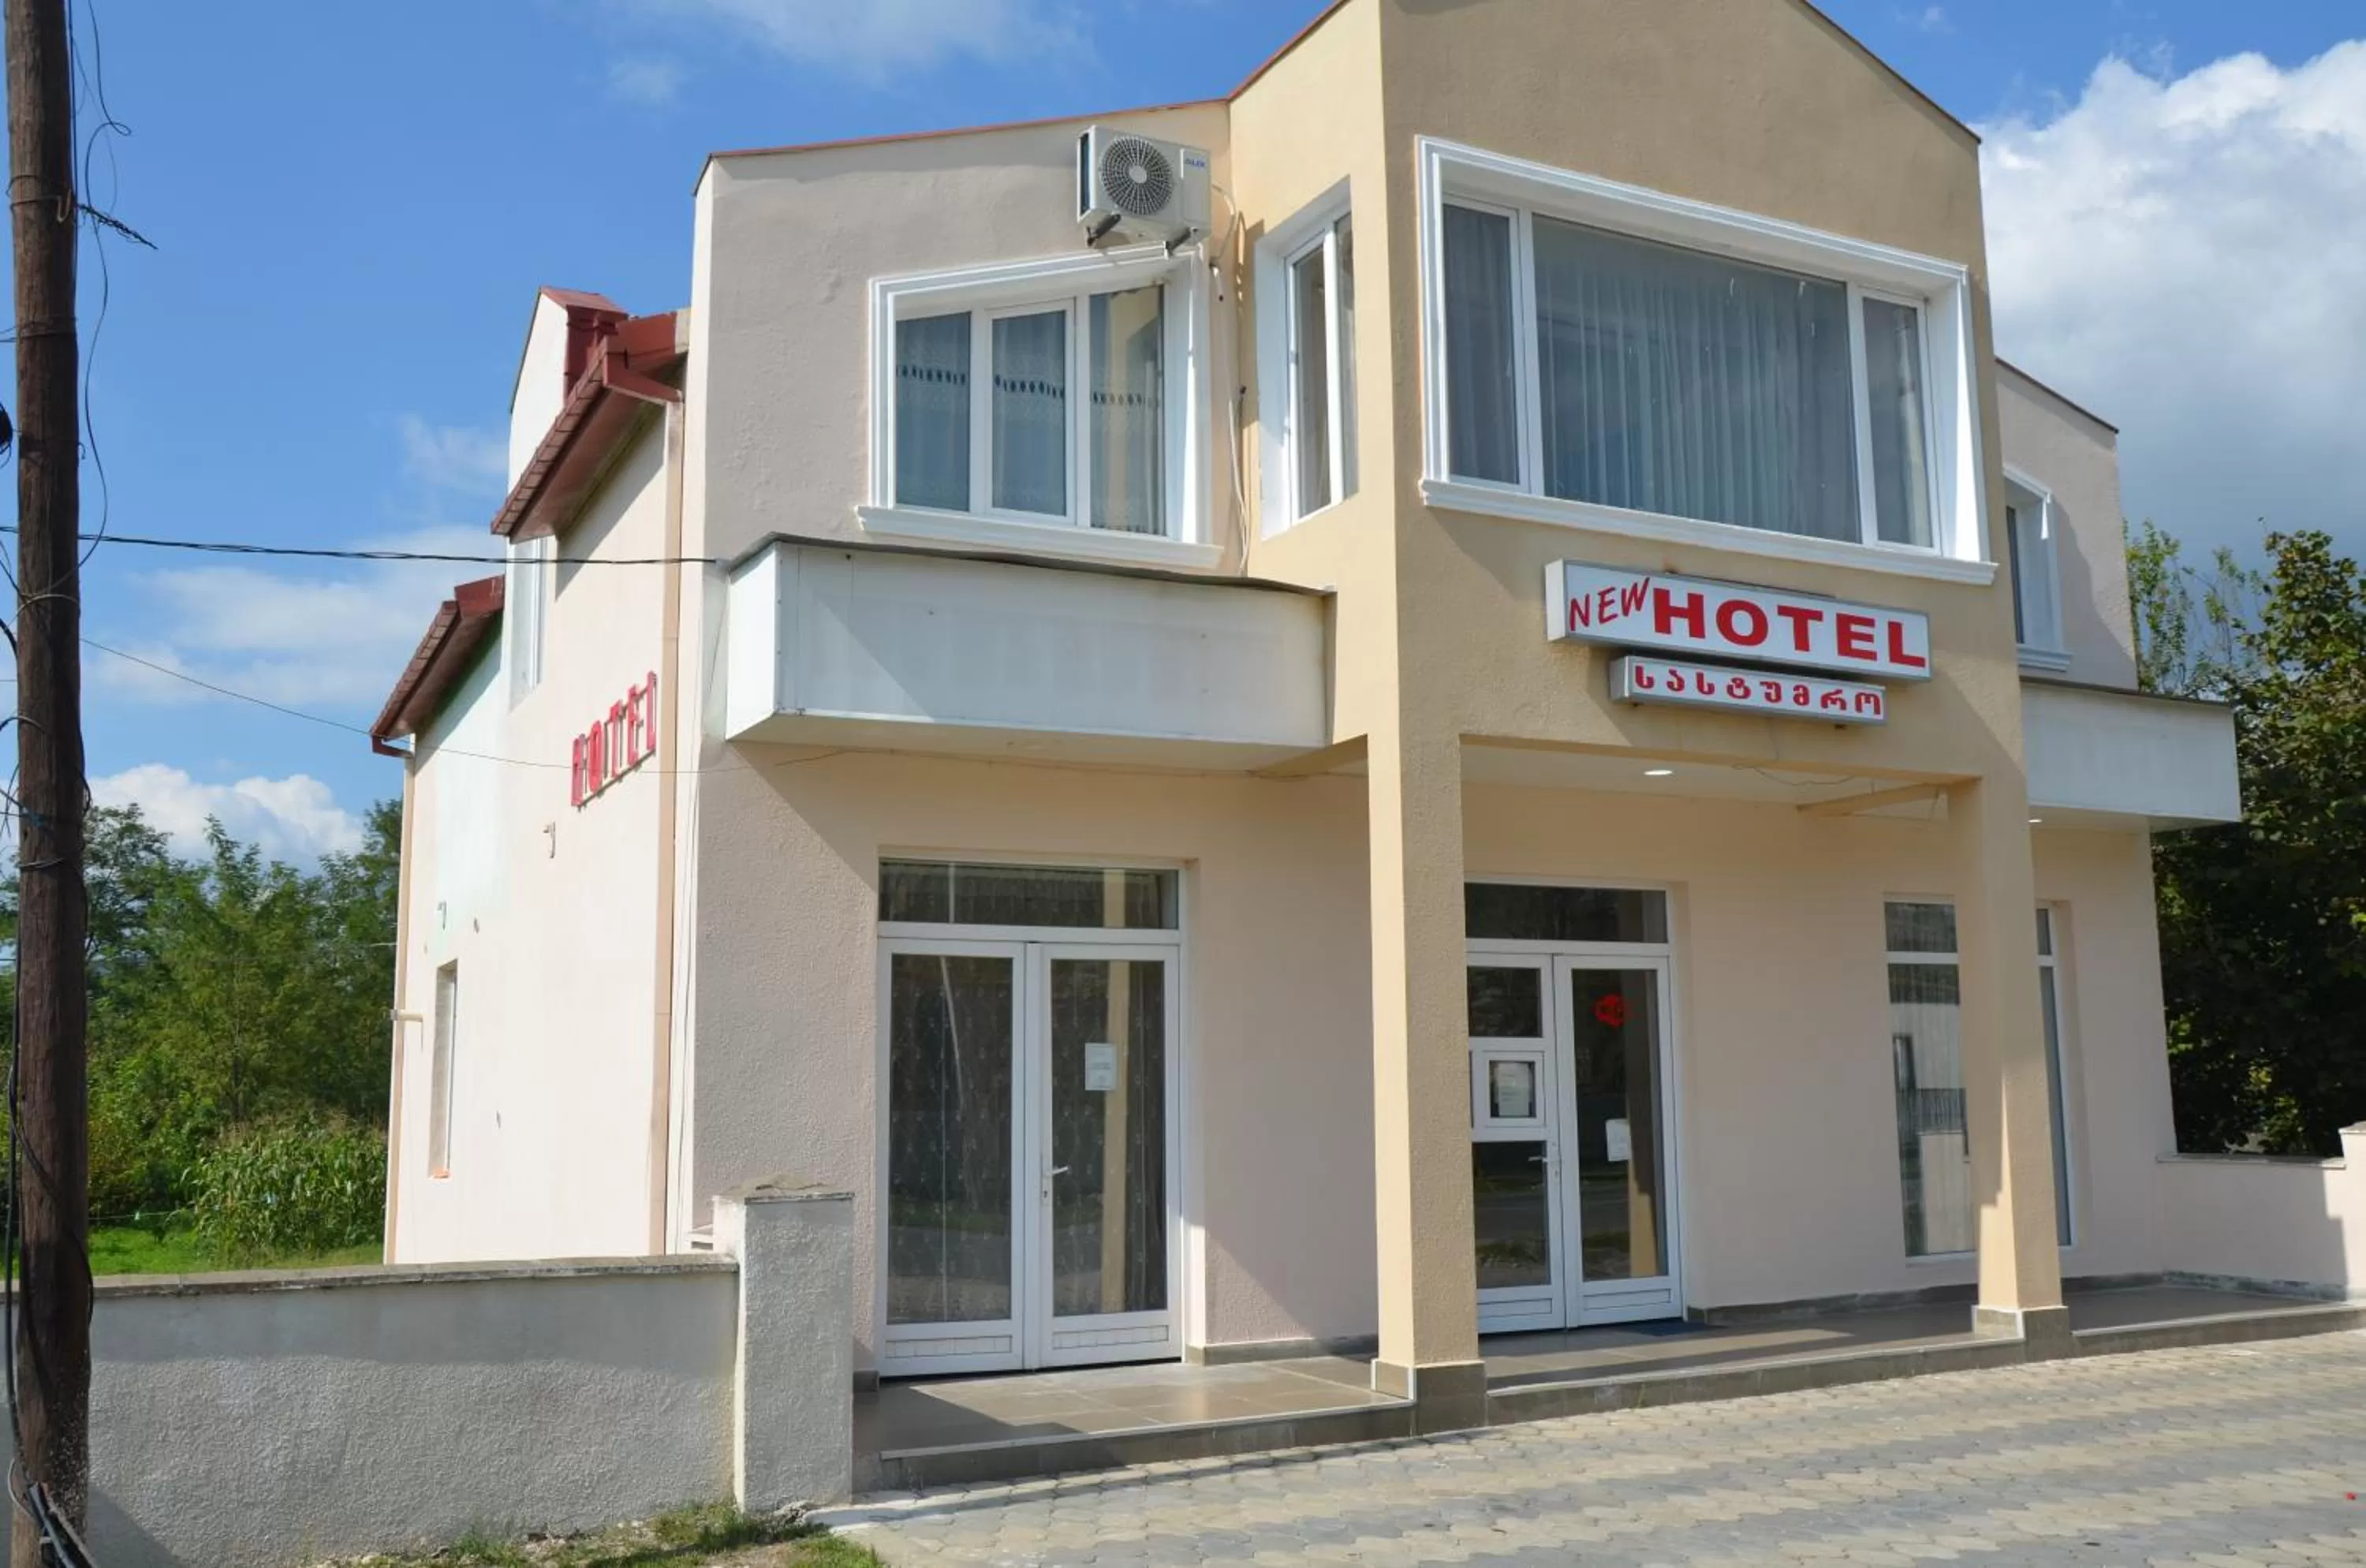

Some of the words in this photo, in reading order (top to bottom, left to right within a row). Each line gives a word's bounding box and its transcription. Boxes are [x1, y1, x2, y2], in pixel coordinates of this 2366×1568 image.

[1569, 577, 1650, 632] NEW
[1653, 588, 1926, 668] HOTEL
[1635, 665, 1881, 715] სასტუმრო
[571, 670, 656, 807] HOTEL
